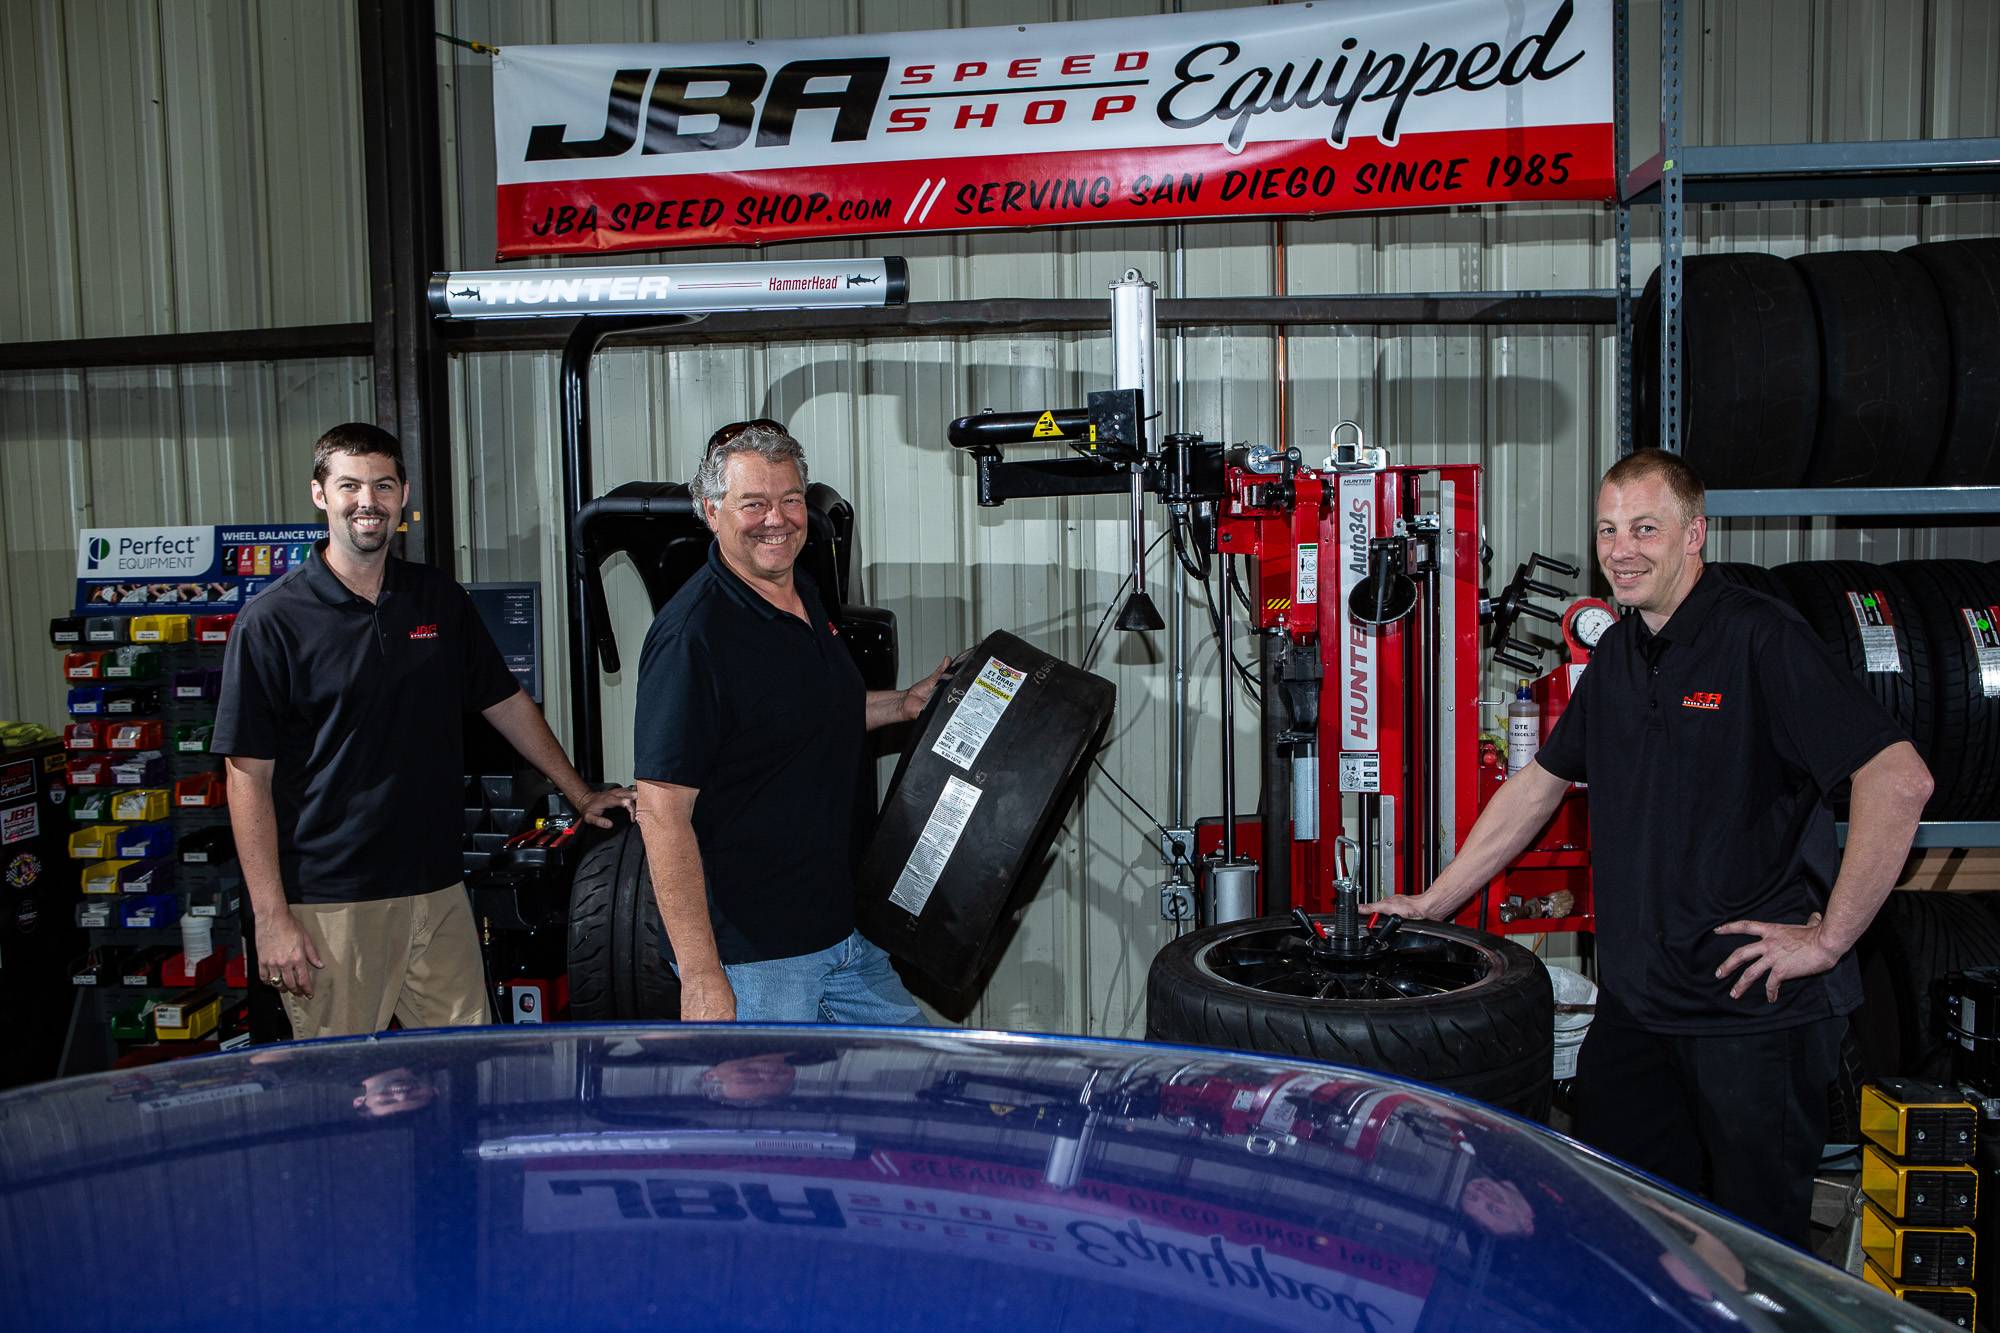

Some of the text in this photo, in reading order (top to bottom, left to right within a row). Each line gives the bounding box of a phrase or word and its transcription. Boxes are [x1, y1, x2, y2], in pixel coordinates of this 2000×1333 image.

[900, 51, 1150, 86] SPEED
[1156, 0, 1586, 149] Equipped
[525, 56, 890, 162] JBA
[886, 95, 1137, 134] SHOP
[533, 206, 598, 237] JBA
[609, 196, 725, 234] SPEED
[955, 176, 1111, 216] SERVING
[1128, 171, 1204, 207] SAN
[1220, 164, 1336, 201] DIEGO
[1353, 158, 1469, 195] SINCE
[1486, 152, 1573, 188] 1985
[485, 275, 671, 305] HUNTER
[768, 274, 838, 292] HammerHead
[119, 536, 195, 555] Perfect
[222, 531, 257, 541] WHEEL
[258, 530, 305, 540] BALANCE
[118, 556, 195, 570] EQUIPMENT
[996, 675, 1015, 688] DRAG
[1350, 622, 1368, 740] HUNTE
